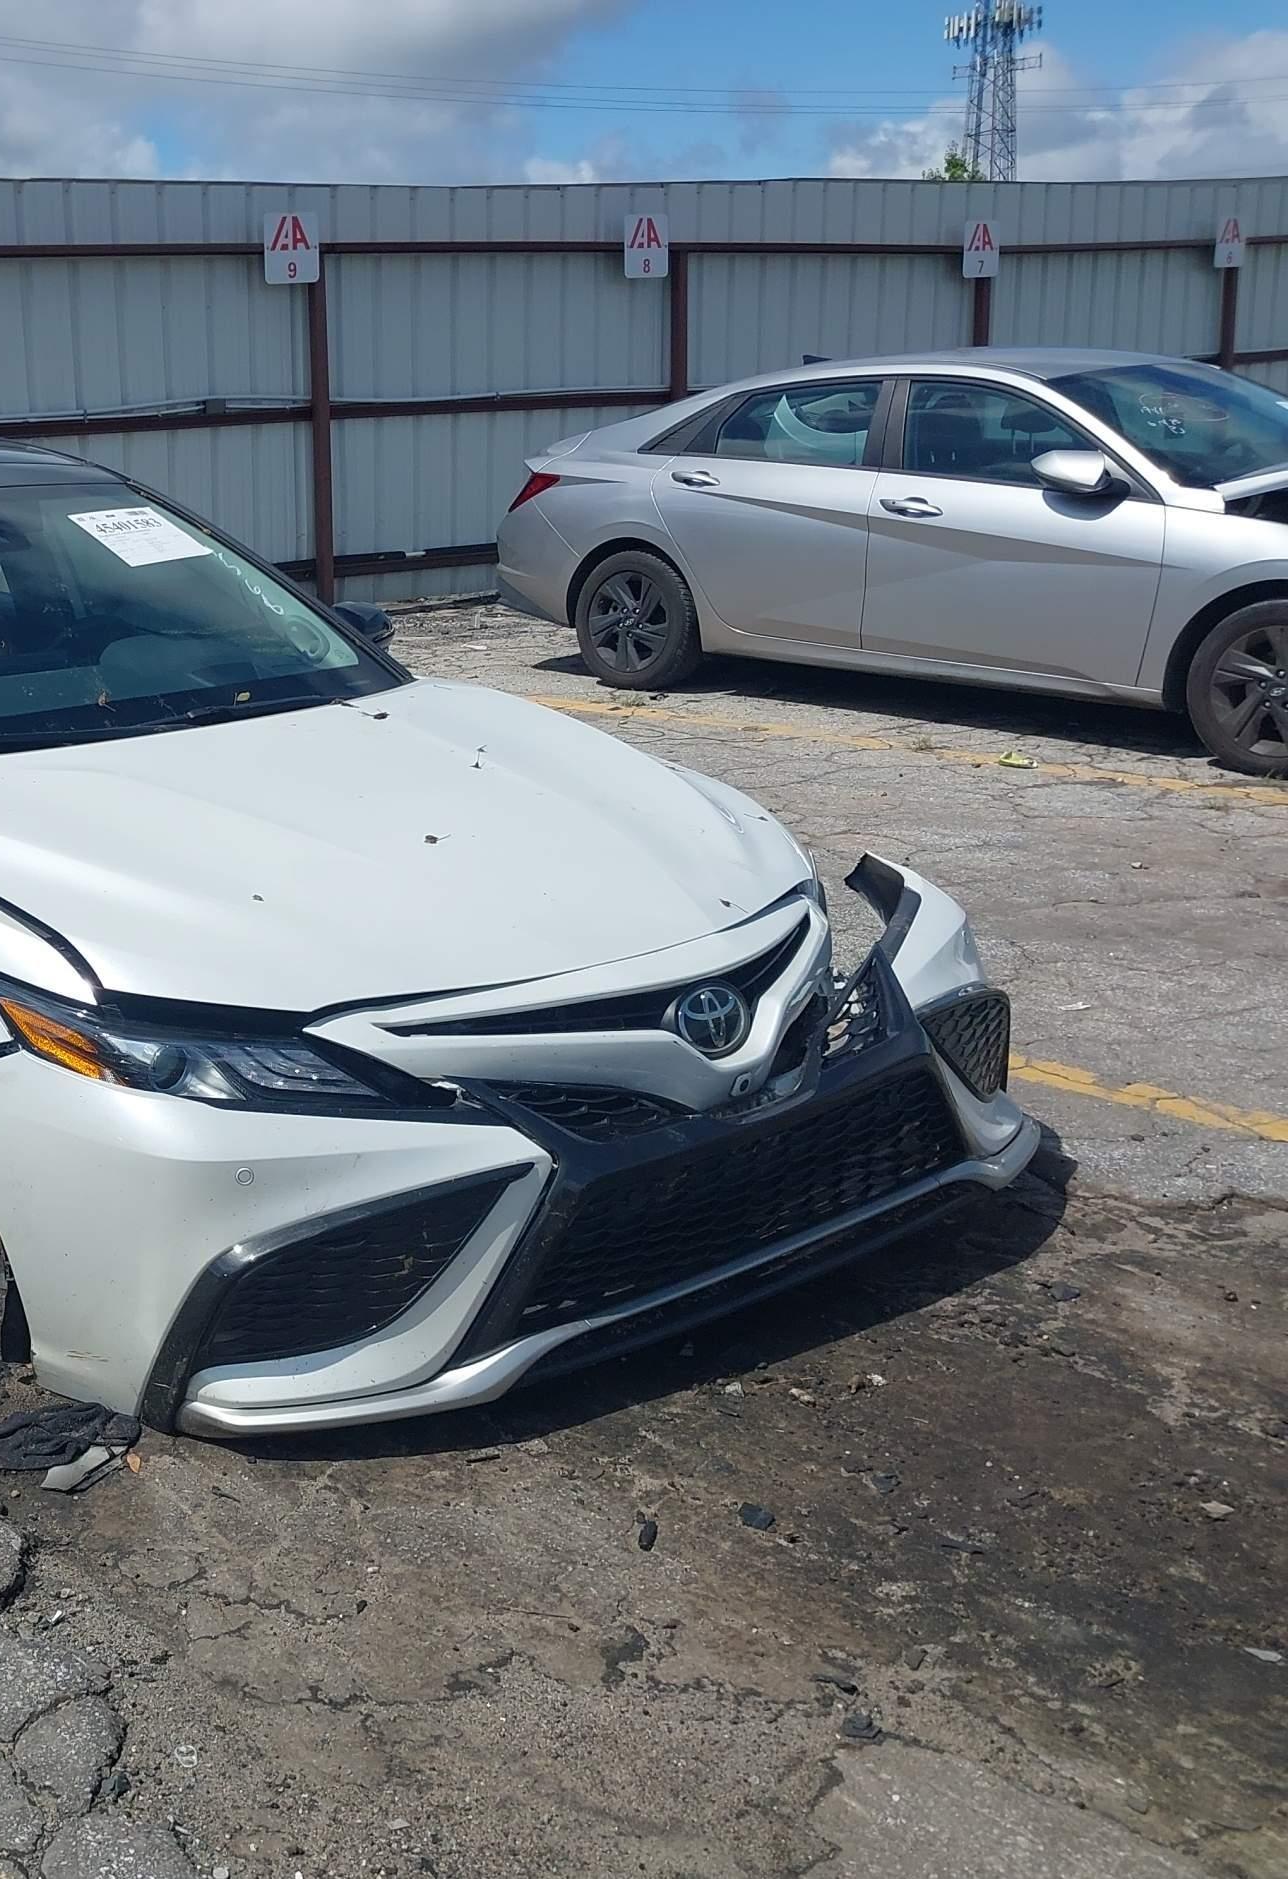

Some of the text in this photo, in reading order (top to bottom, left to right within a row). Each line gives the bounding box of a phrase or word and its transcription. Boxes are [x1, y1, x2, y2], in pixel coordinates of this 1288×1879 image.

[1226, 251, 1233, 265] 6
[288, 262, 297, 279] 9
[643, 258, 650, 274] 8
[977, 260, 984, 273] 7
